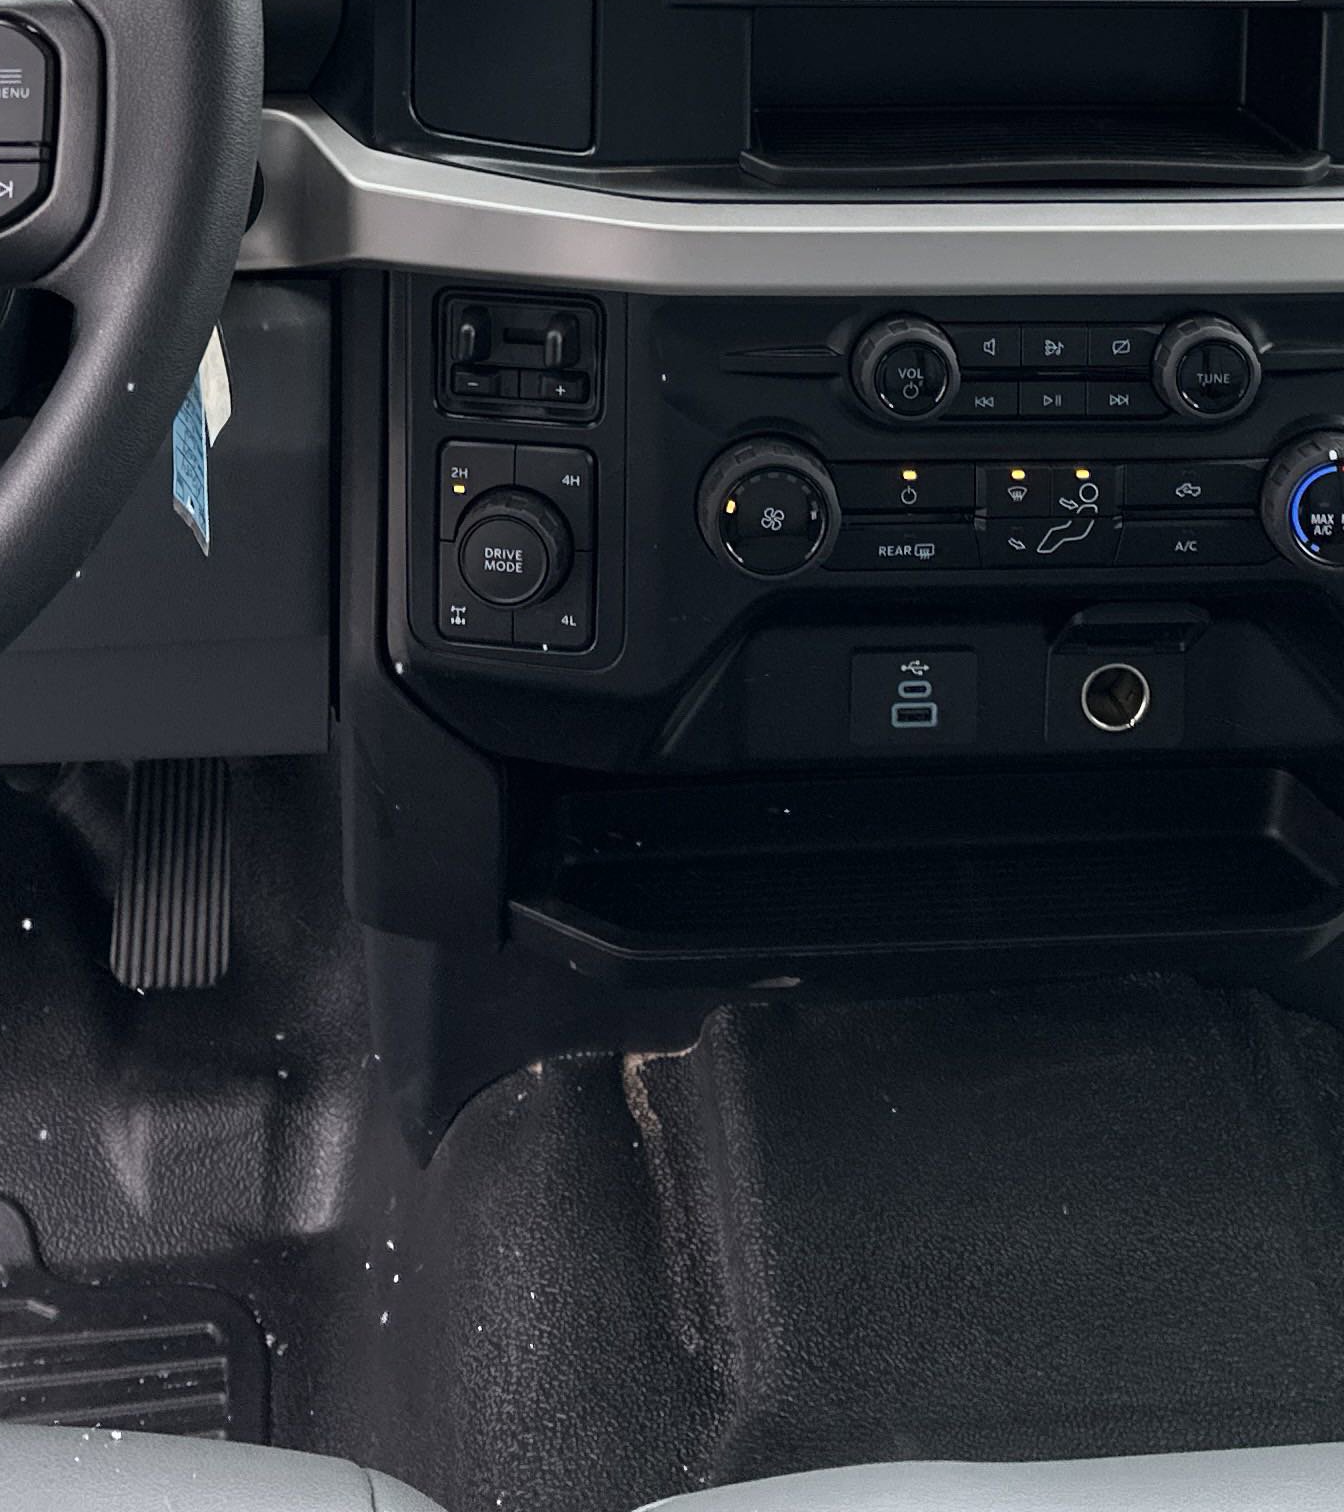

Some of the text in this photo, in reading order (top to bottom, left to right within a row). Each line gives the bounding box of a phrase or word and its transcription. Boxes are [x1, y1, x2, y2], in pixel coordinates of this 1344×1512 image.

[898, 368, 924, 379] VOL
[1197, 373, 1230, 384] TUNE
[451, 467, 468, 479] 2H
[562, 475, 580, 487] 4H
[1311, 513, 1334, 525] MAX
[1313, 525, 1333, 536] A/C
[878, 545, 912, 557] REAR
[1174, 540, 1198, 552] A/C
[484, 548, 523, 561] DRIVE
[484, 561, 523, 573] MODE
[561, 615, 576, 627] 4L
